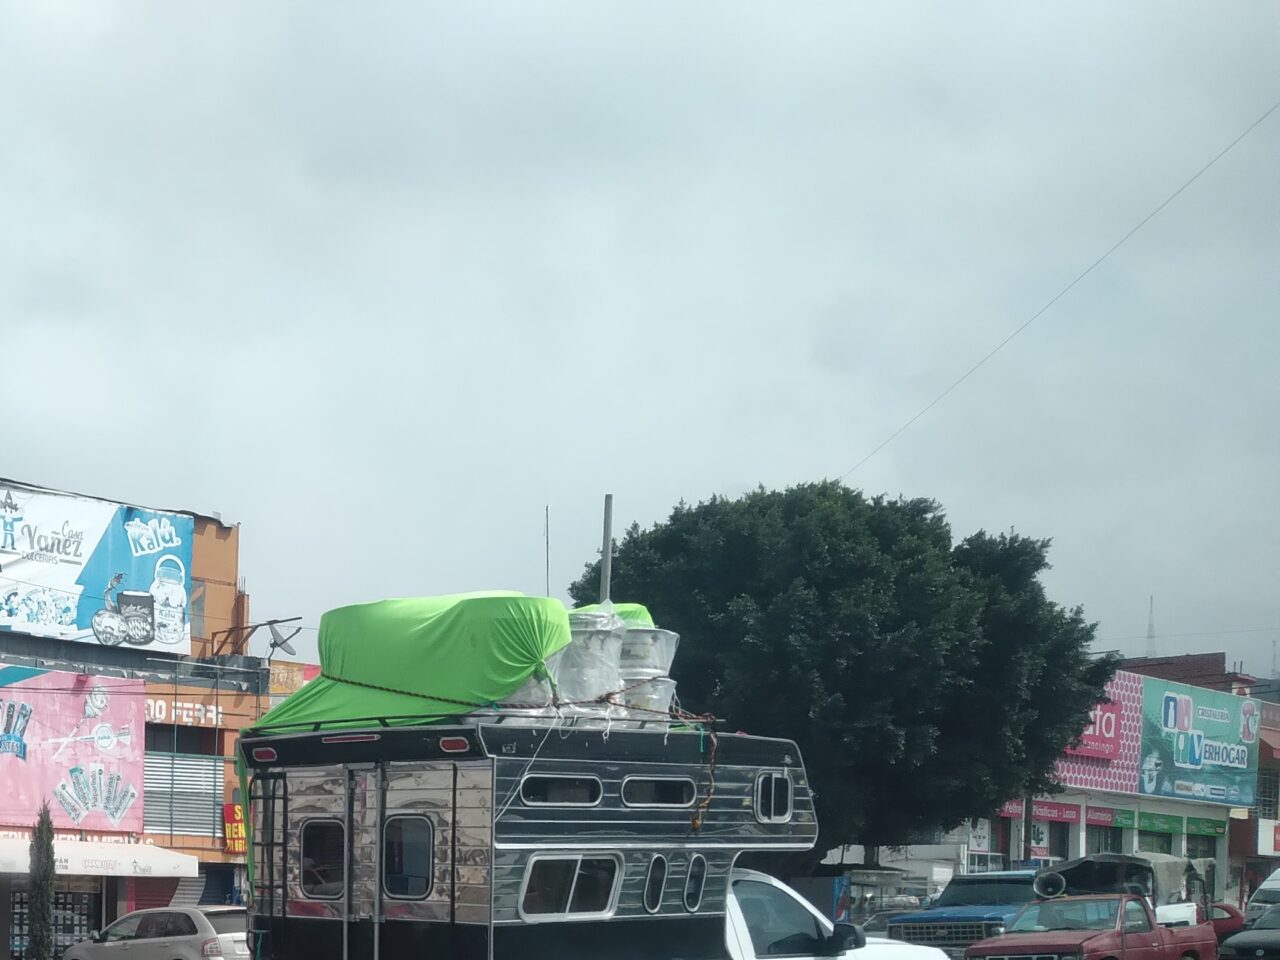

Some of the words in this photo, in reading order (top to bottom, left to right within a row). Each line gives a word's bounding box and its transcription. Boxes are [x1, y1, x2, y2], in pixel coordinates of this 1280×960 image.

[62, 520, 84, 540] Casa
[21, 524, 83, 558] Yañez
[21, 551, 59, 565] DULCERIAS
